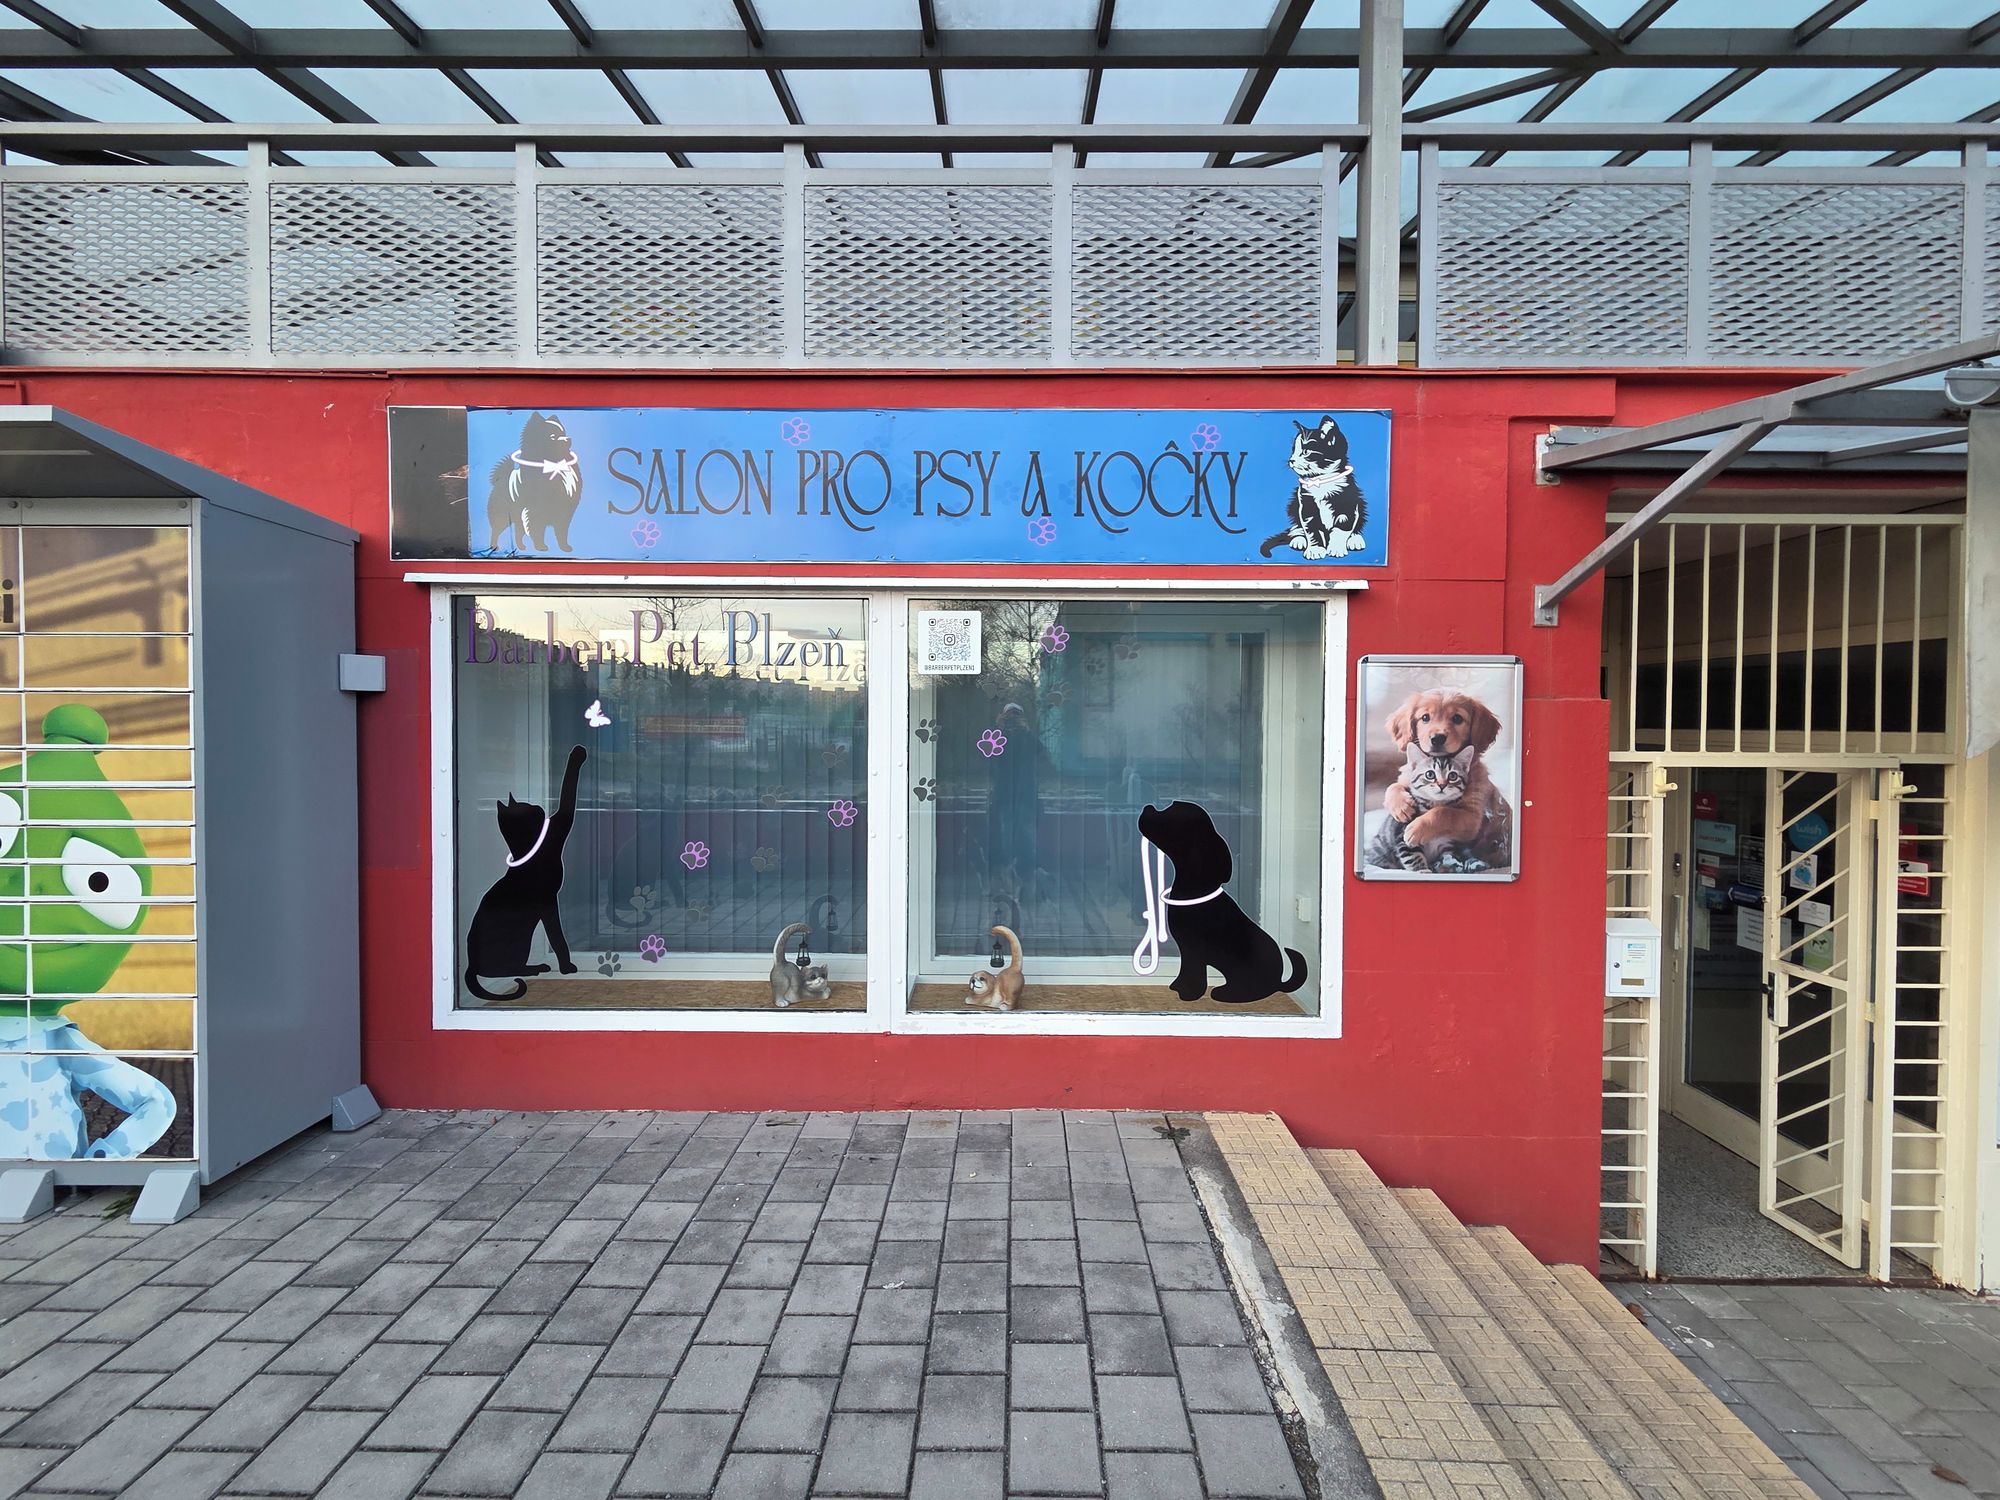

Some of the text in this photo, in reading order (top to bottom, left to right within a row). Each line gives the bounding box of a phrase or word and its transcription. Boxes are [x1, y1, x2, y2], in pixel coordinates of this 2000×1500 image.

[607, 447, 774, 516] SALON
[796, 448, 892, 533] PRO
[912, 449, 1000, 518] PSY
[1021, 450, 1052, 518] A
[464, 607, 850, 668] Barber Pet Plzeň
